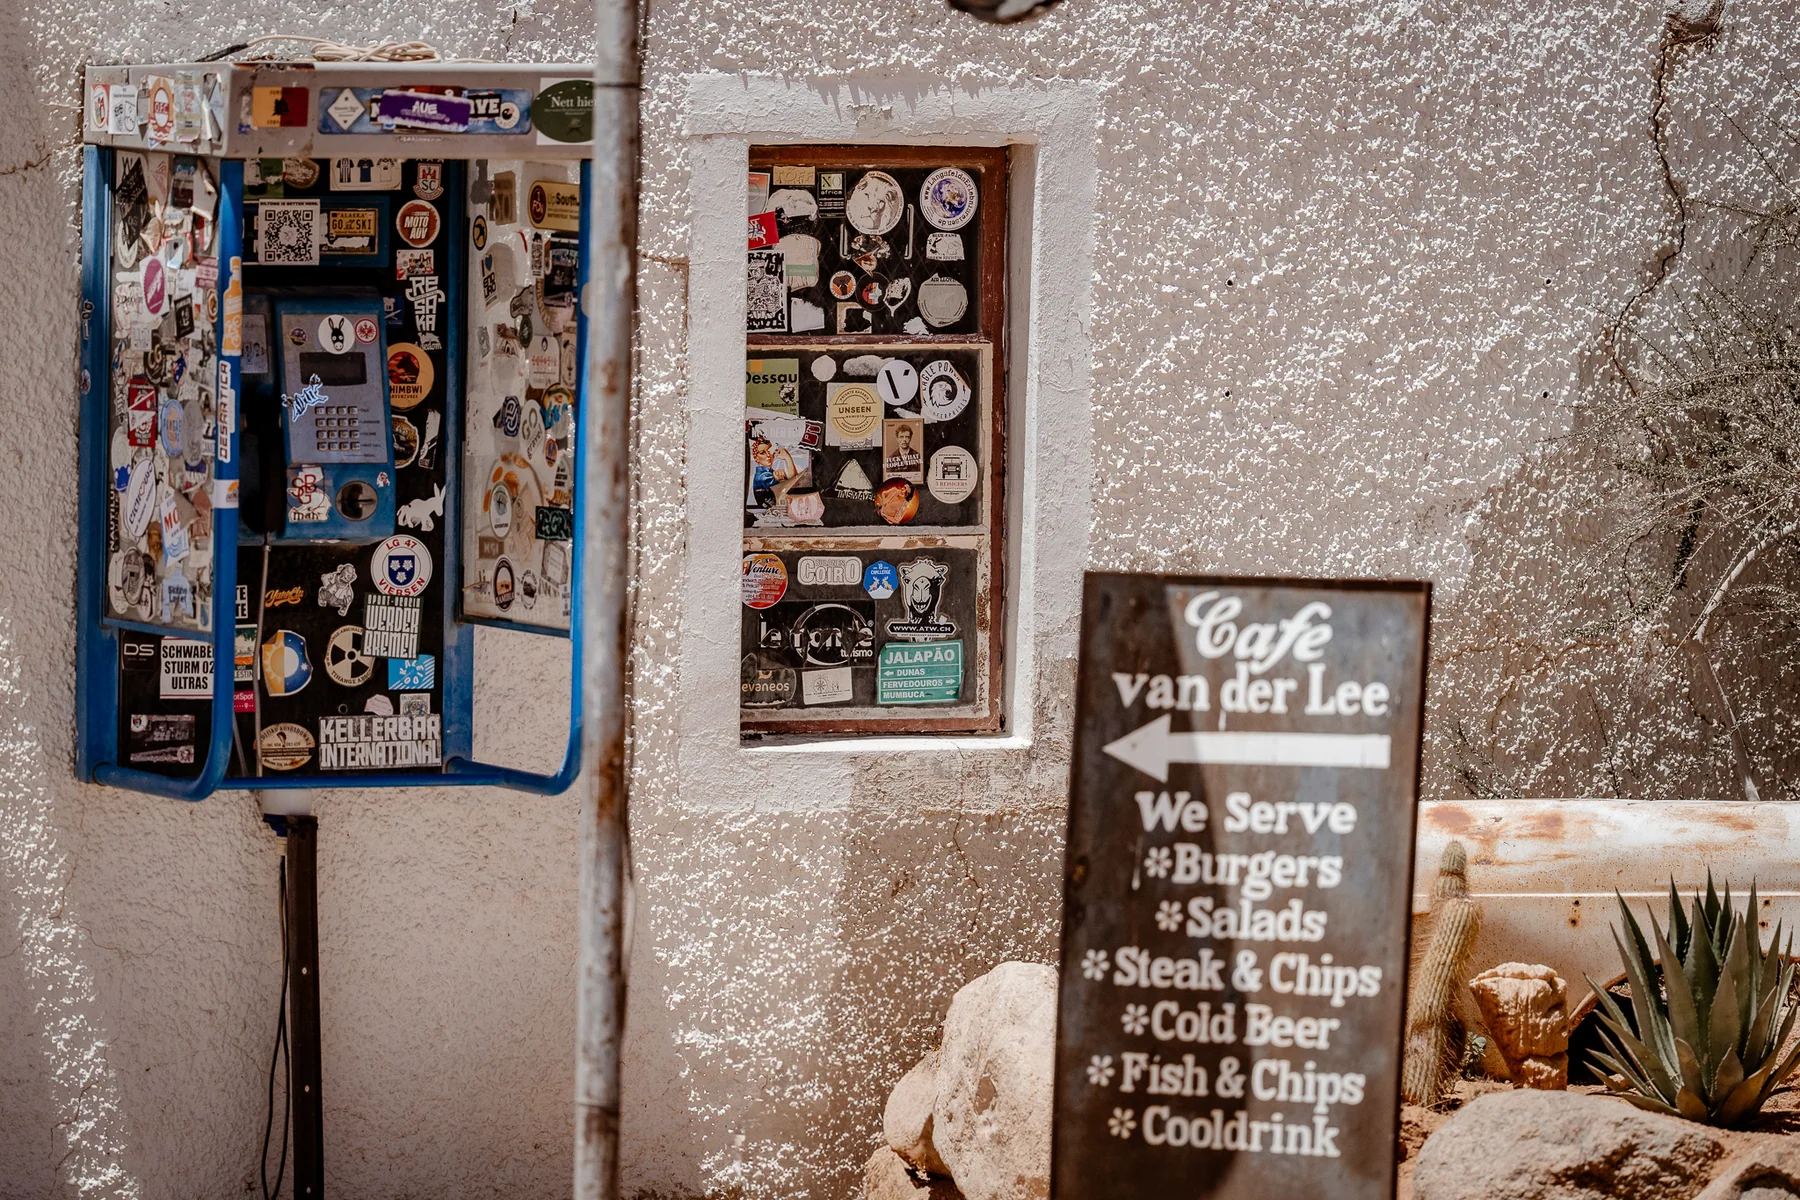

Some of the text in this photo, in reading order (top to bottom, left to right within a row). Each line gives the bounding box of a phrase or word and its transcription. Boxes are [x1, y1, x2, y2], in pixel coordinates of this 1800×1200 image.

[411, 100, 438, 115] AUE
[551, 96, 574, 108] Nett
[421, 180, 436, 191] SC
[332, 219, 372, 230] GO SKI
[404, 216, 429, 228] MOTO
[409, 228, 428, 239] ADV
[389, 385, 423, 394] HIMBWI
[838, 406, 872, 414] UNSEEN
[385, 538, 418, 551] LG 47
[379, 577, 426, 597] VIERSEN
[365, 605, 420, 634] WERDER
[1185, 591, 1333, 674] Cafe
[123, 643, 155, 656] DS
[162, 645, 214, 658] SCHWABE
[363, 630, 418, 659] BREMEN
[885, 647, 955, 665] JALAPÃO
[164, 660, 214, 675] STURM 02
[896, 668, 926, 677] DUNAS
[171, 676, 208, 690] ULTRAS
[741, 682, 790, 692] evaneos
[882, 679, 943, 689] FERVEDOUROS
[1112, 662, 1390, 716] van der Lee
[234, 692, 254, 701] otSpot
[883, 691, 925, 699] MUMBUCA
[320, 716, 440, 743] KELLERBAR
[320, 740, 441, 767] INTERNATIONAL
[1135, 791, 1357, 834] We Serve
[1171, 842, 1343, 900] Burgers
[1186, 896, 1327, 942] Salads
[1113, 945, 1382, 1007] Steak & Chips
[1151, 1001, 1341, 1049] Cold Beer
[1120, 1052, 1366, 1114] Fish & Chips
[1143, 1106, 1341, 1157] Cooldrink
